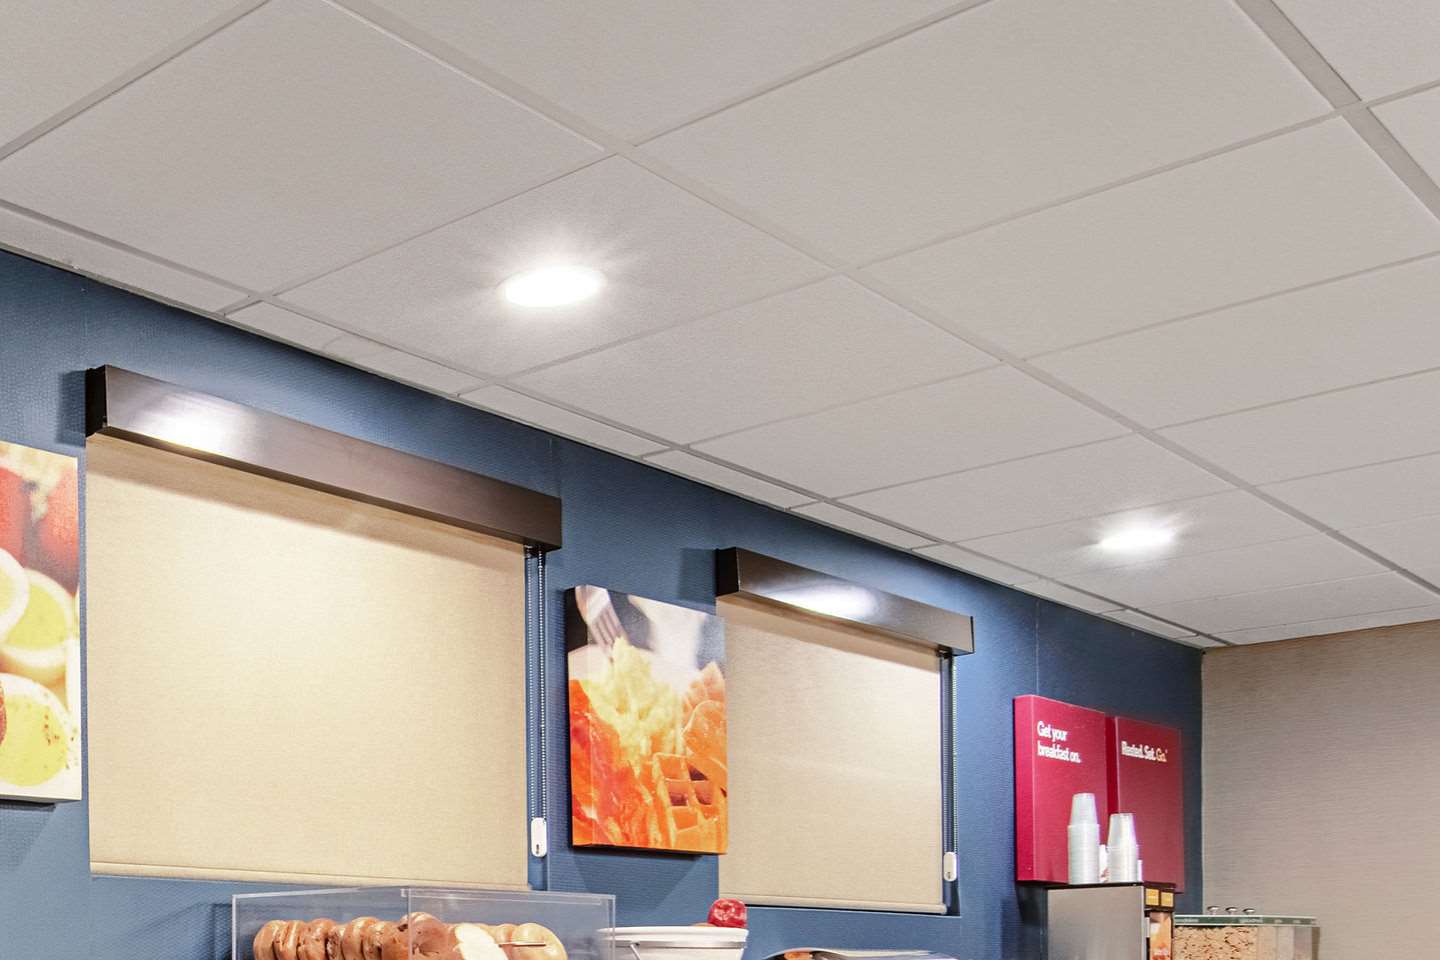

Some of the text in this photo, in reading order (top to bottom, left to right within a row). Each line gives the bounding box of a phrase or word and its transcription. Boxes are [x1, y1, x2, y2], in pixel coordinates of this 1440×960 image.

[1037, 720, 1068, 742] Get your
[1038, 740, 1070, 761] breakfast
